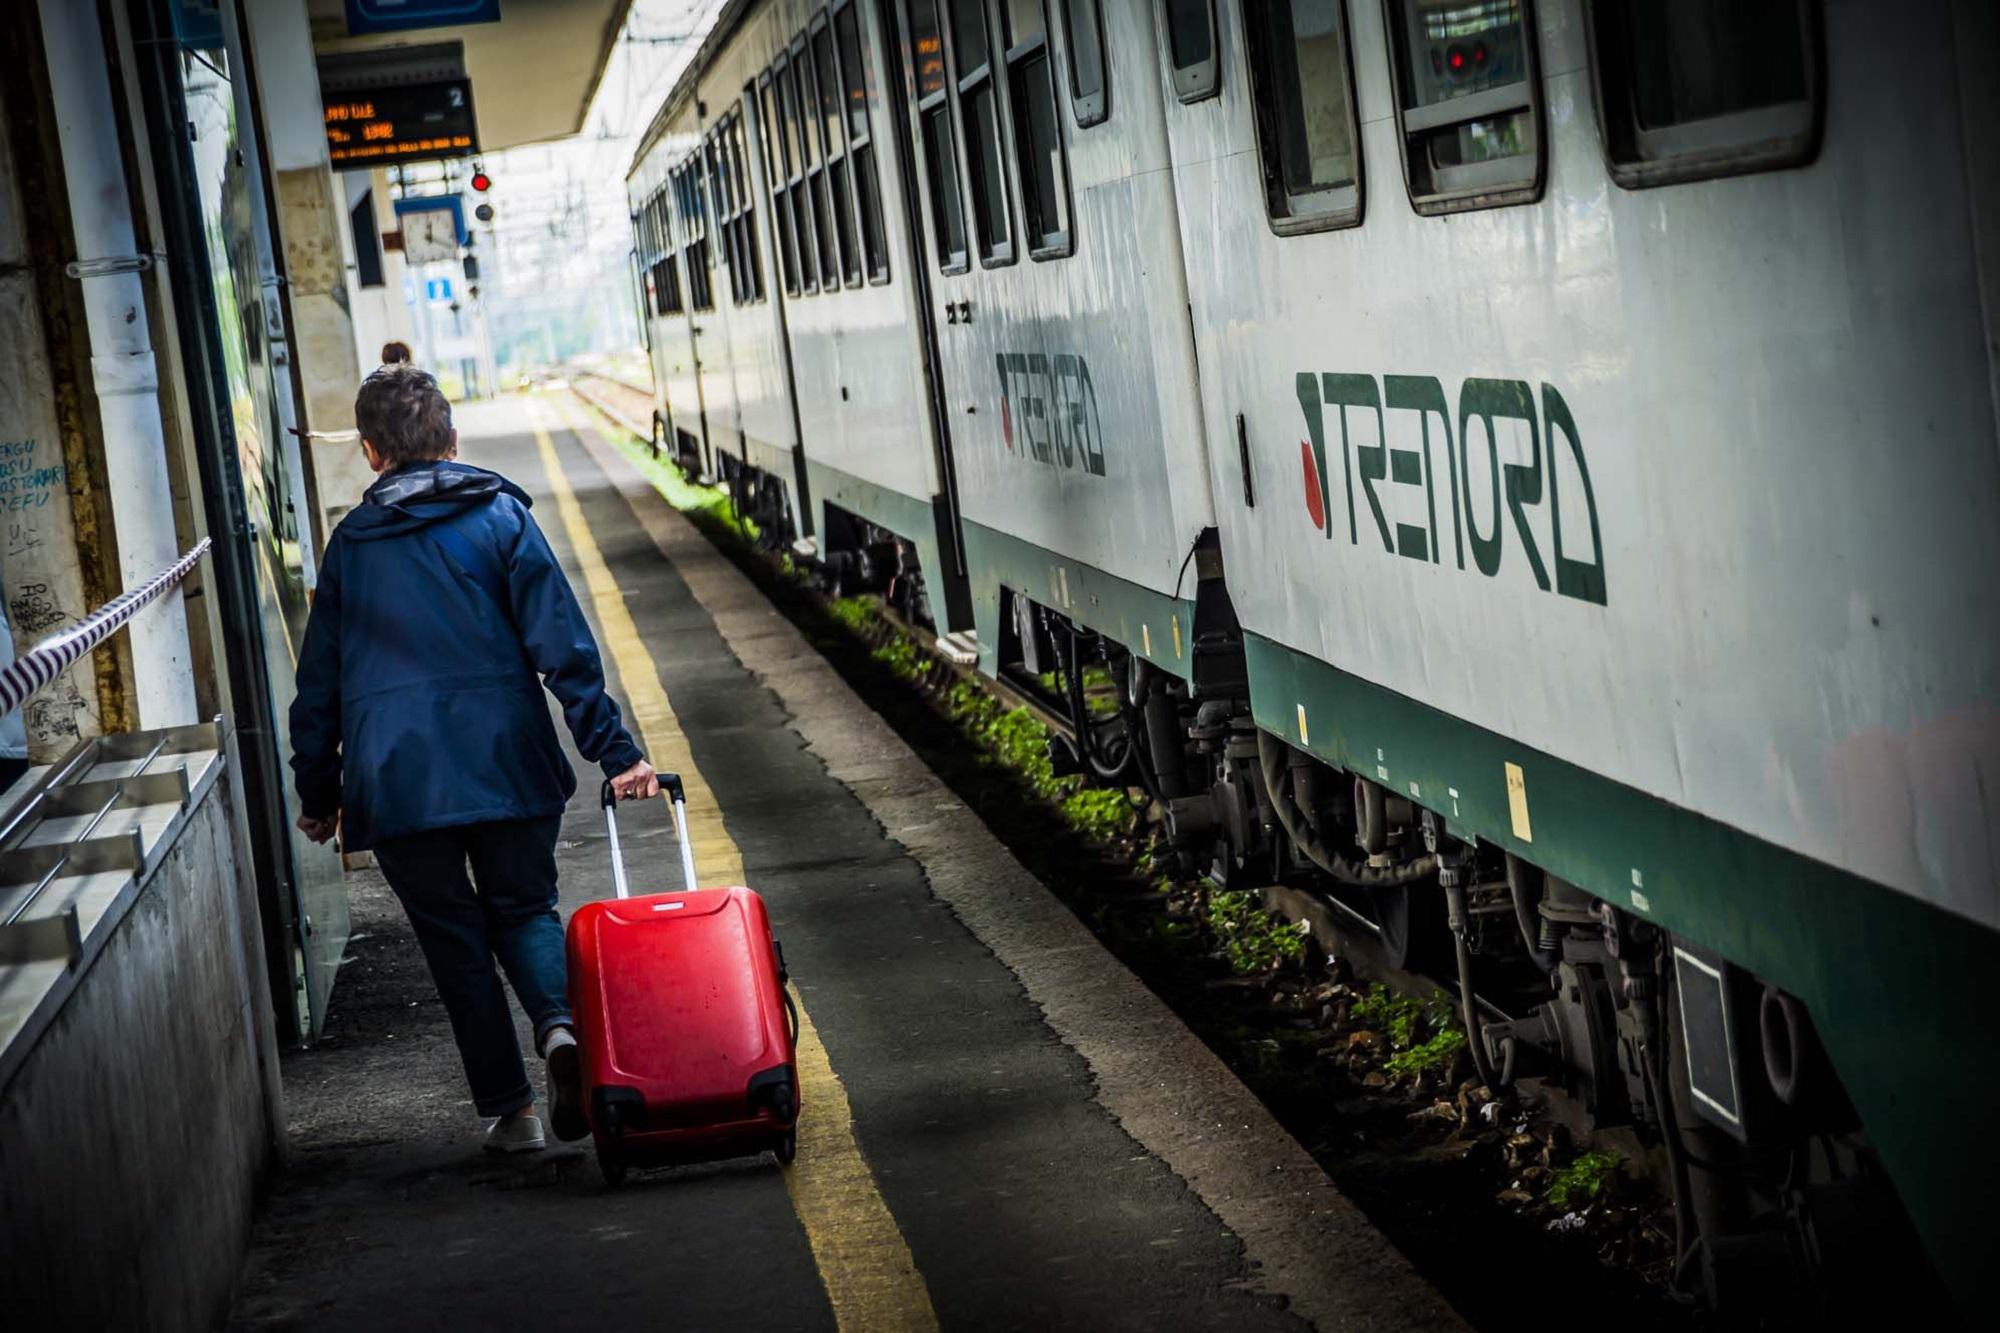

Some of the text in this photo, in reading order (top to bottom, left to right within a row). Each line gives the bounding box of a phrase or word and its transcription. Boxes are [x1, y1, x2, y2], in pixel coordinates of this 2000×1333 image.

[449, 88, 463, 106] 2
[996, 353, 1106, 477] TRENORD
[1296, 372, 1608, 607] TRENORD
